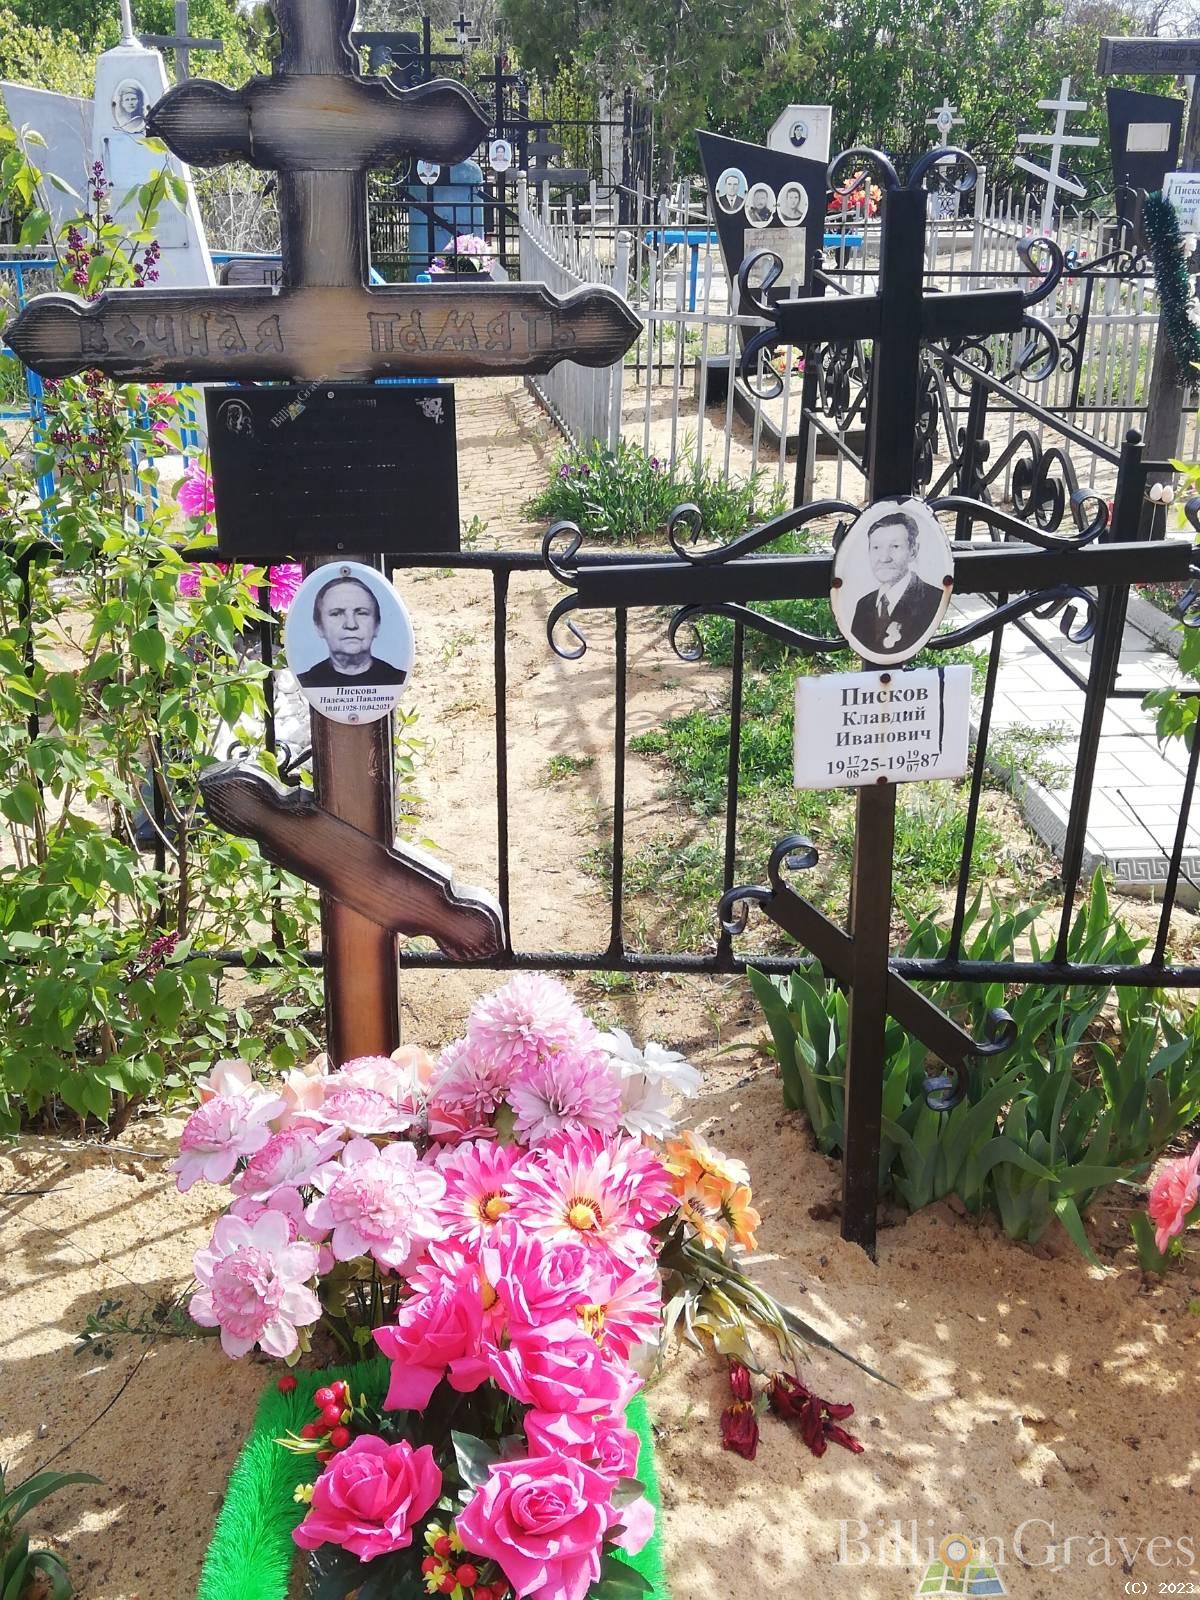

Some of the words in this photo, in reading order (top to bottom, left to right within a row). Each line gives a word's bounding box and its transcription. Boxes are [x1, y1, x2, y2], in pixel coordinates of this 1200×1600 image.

[336, 687, 377, 695] Пискова
[840, 687, 929, 706] Писков
[842, 706, 926, 727] Клавдий
[836, 729, 932, 747] Иванович
